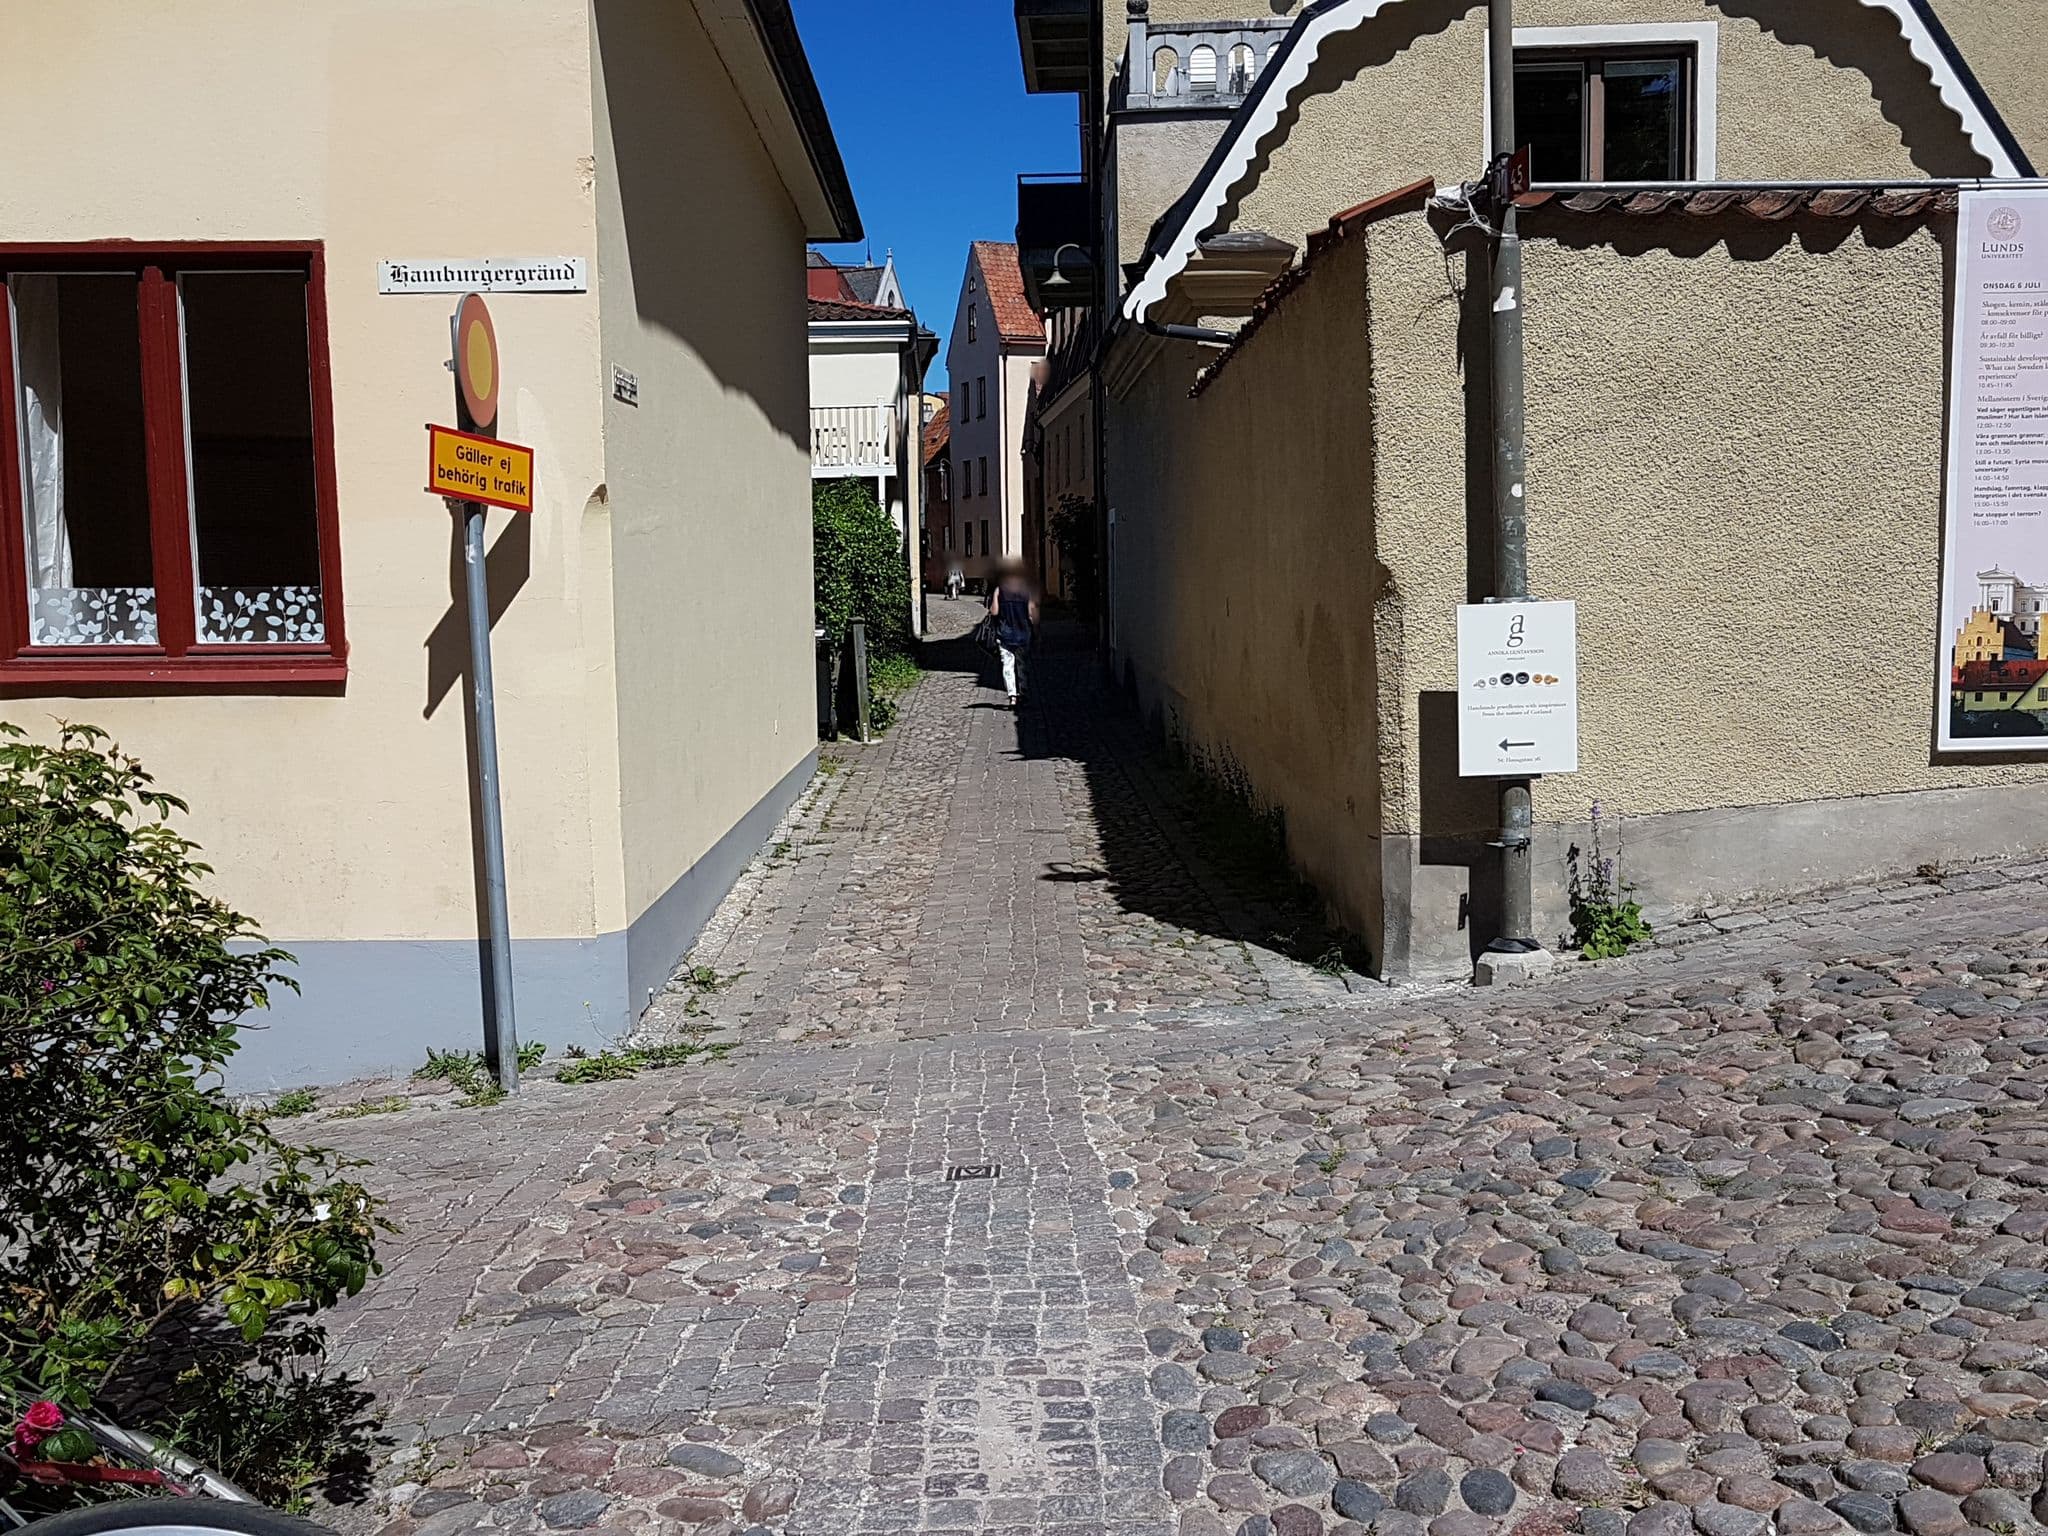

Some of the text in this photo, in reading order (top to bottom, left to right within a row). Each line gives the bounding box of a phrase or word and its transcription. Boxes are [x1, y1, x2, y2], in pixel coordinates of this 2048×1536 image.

[1982, 242, 2024, 252] LUNDS
[389, 264, 576, 287] Hamburgergränd
[1979, 354, 2016, 362] Sustainable
[456, 445, 511, 474] Gäller ej
[438, 464, 526, 496] behörig trafik
